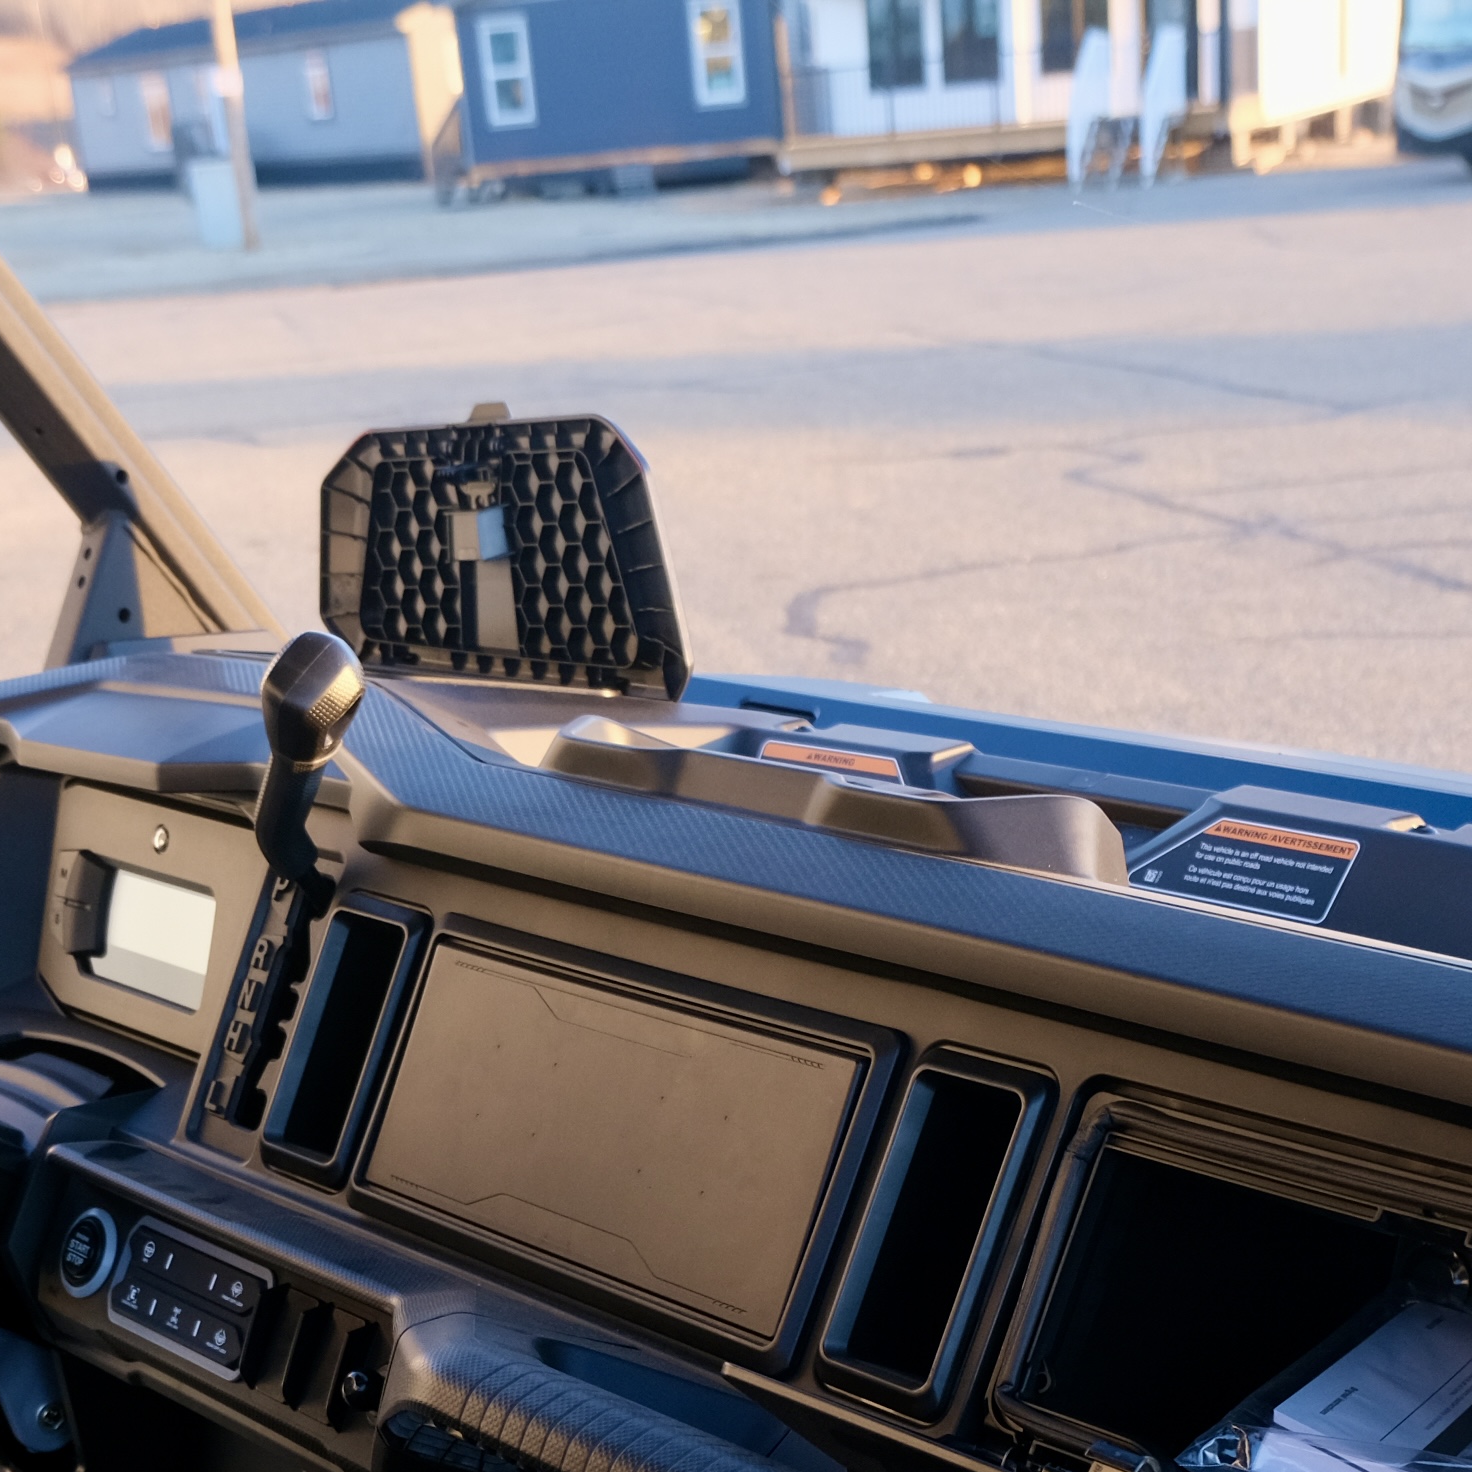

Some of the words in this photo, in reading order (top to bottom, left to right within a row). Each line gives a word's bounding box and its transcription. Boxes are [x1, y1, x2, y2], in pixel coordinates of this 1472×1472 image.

[812, 753, 856, 766] WARNING
[251, 939, 268, 969] R
[238, 978, 257, 1010] N
[224, 1020, 244, 1051] H
[67, 1252, 84, 1265] STOP
[69, 1239, 91, 1255] START
